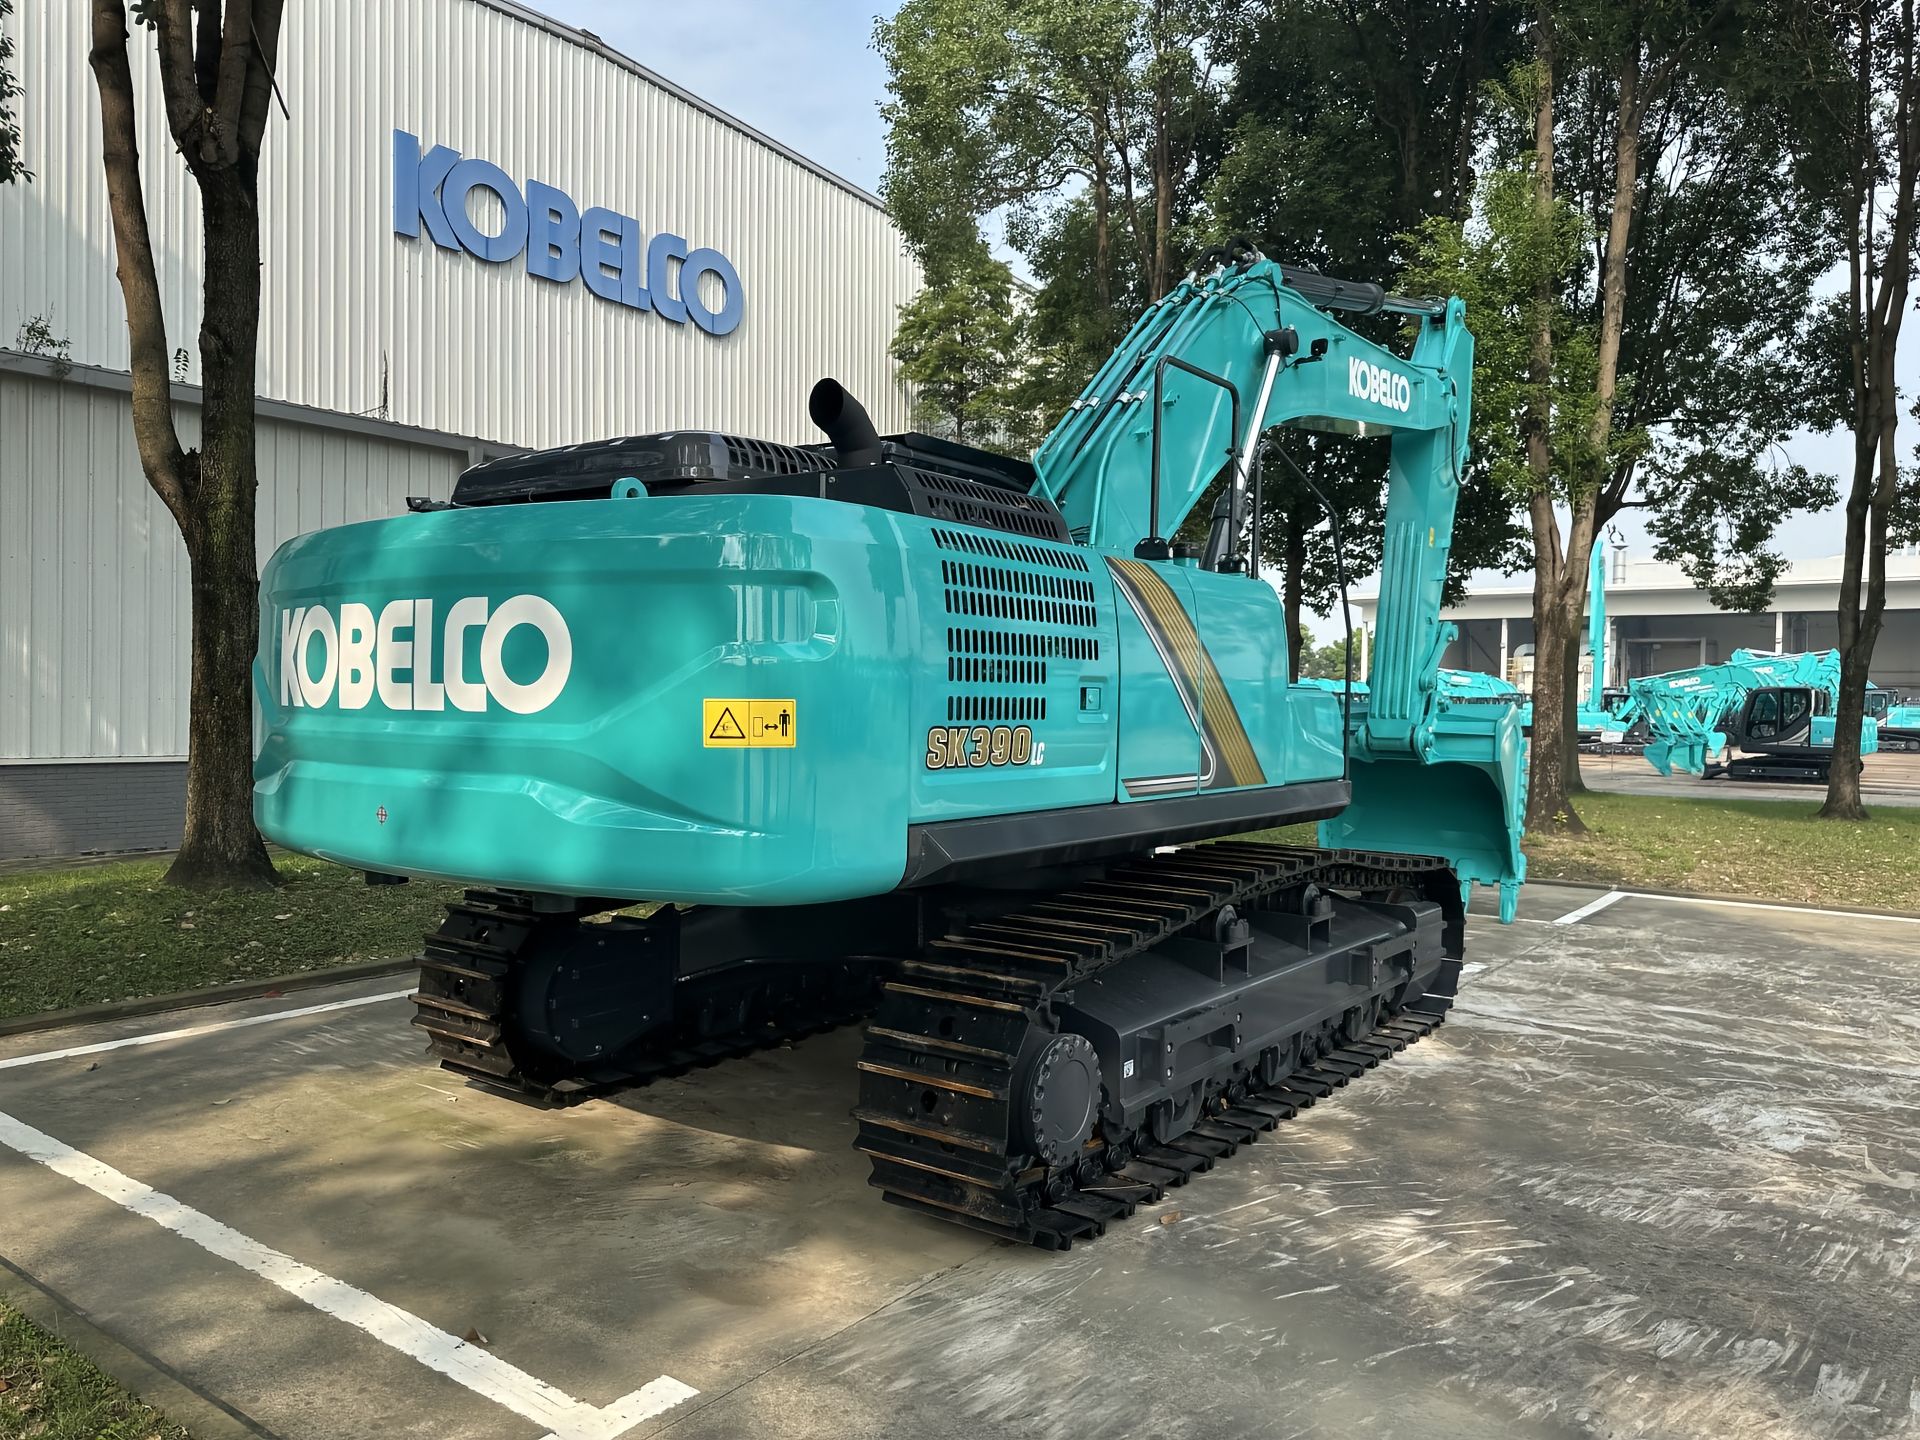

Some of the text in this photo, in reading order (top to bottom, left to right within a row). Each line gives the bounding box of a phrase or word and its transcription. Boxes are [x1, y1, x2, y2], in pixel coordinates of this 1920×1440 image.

[393, 128, 744, 336] KOBELCO
[1348, 355, 1411, 413] KOBELCO
[280, 594, 573, 715] KOBELCO
[926, 726, 1032, 769] SK390
